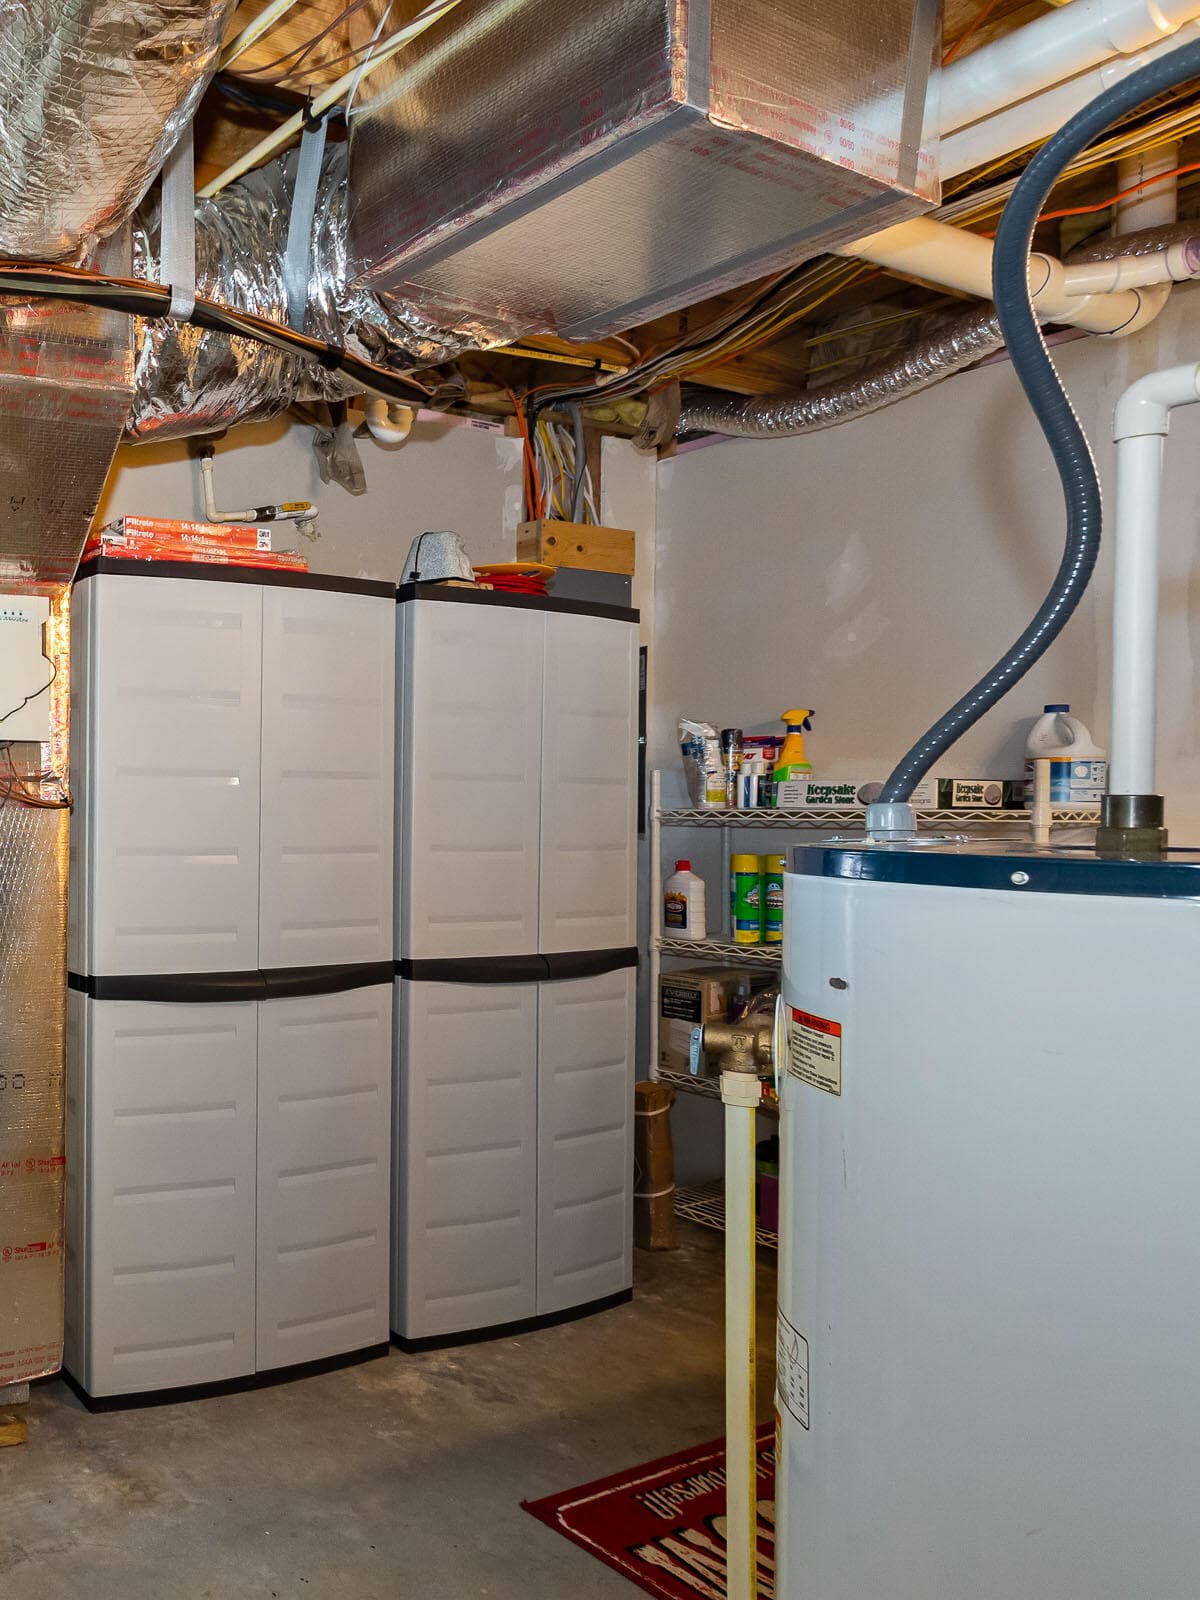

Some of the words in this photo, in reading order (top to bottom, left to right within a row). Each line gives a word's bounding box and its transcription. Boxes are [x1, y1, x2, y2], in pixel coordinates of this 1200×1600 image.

[807, 784, 857, 797] Keepsake
[956, 783, 984, 794] Keepsake
[806, 795, 833, 805] Garden
[834, 796, 856, 805] Stone
